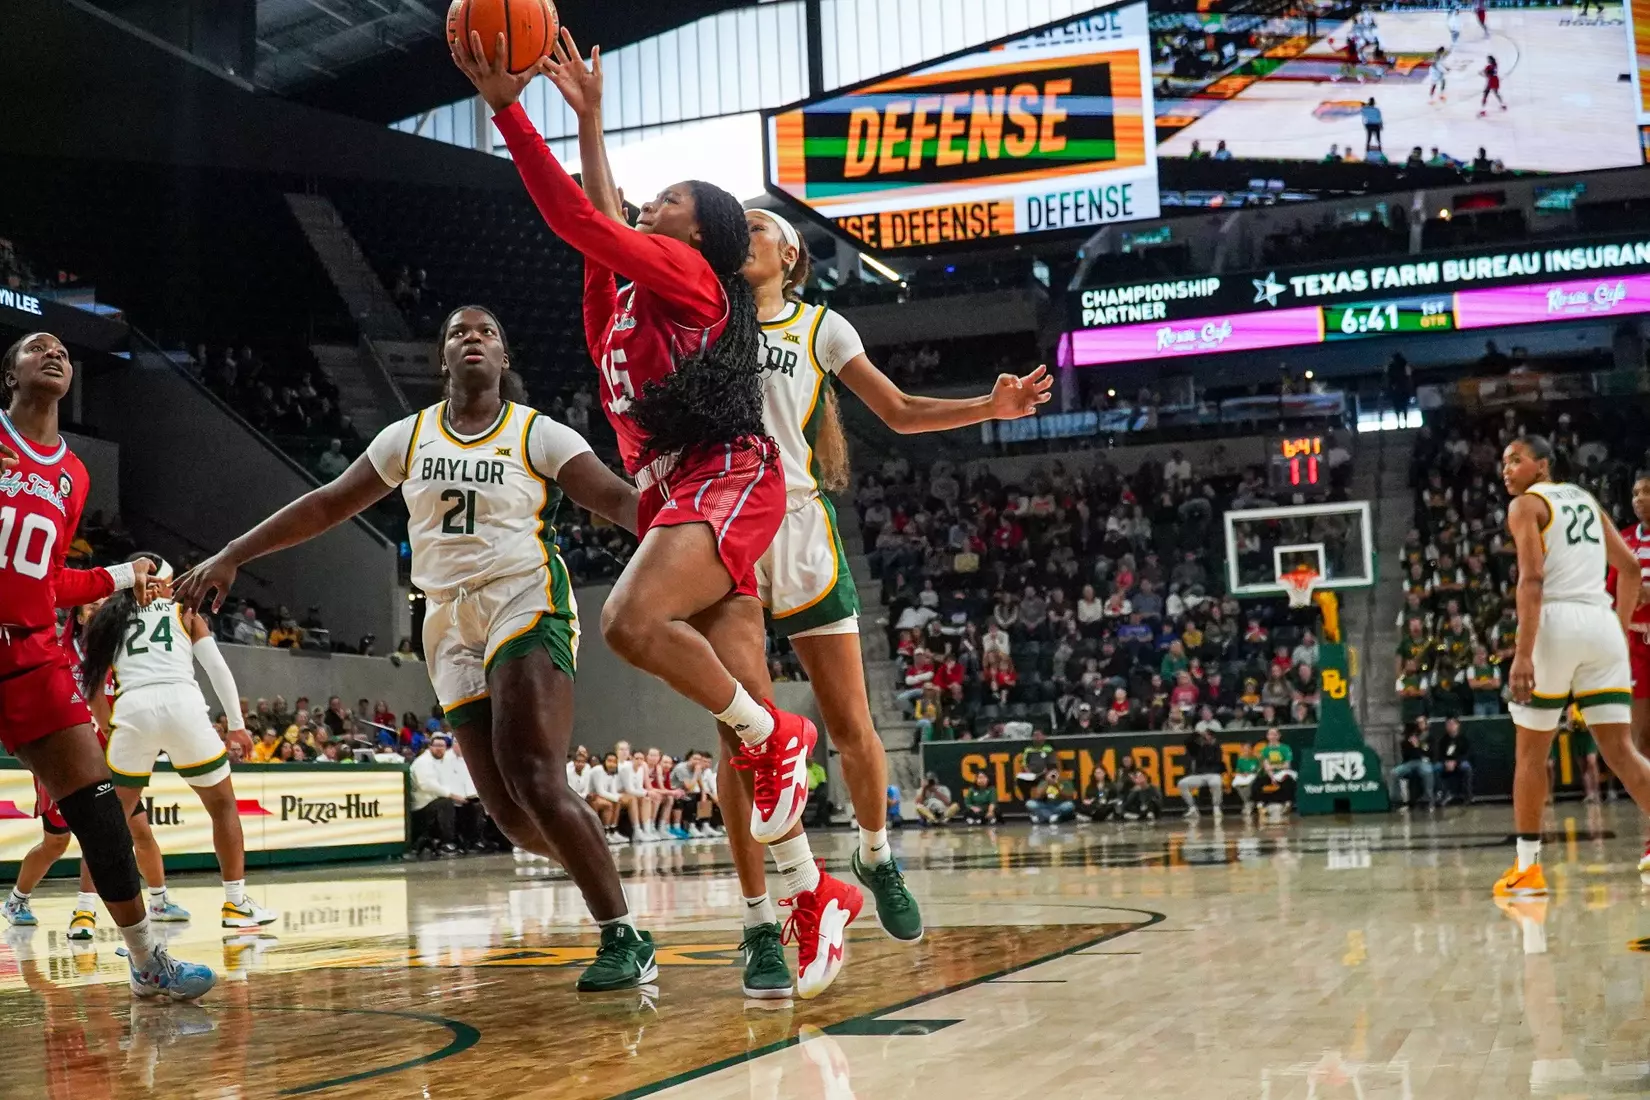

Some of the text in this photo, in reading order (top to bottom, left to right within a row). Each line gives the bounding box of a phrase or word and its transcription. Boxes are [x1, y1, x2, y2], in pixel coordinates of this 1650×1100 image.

[844, 78, 1072, 178] DEFENSE
[892, 201, 999, 246] DEFENSE
[1027, 183, 1133, 231] DEFENSE
[1081, 277, 1221, 309] CHAMPIONSHIP
[1289, 269, 1369, 297] TEXAS
[1371, 262, 1439, 290] FARM
[1442, 251, 1541, 282] BUREAU
[1082, 301, 1166, 326] PARTNER
[1341, 303, 1398, 334] 6:41
[601, 348, 636, 414] 15
[422, 457, 504, 485] BAYLOR
[441, 489, 476, 534] 21
[1561, 504, 1600, 546] 22
[0, 506, 57, 580] 10
[126, 616, 173, 657] 24
[1325, 782, 1346, 793] Bank
[281, 794, 381, 824] Pizza Hut
